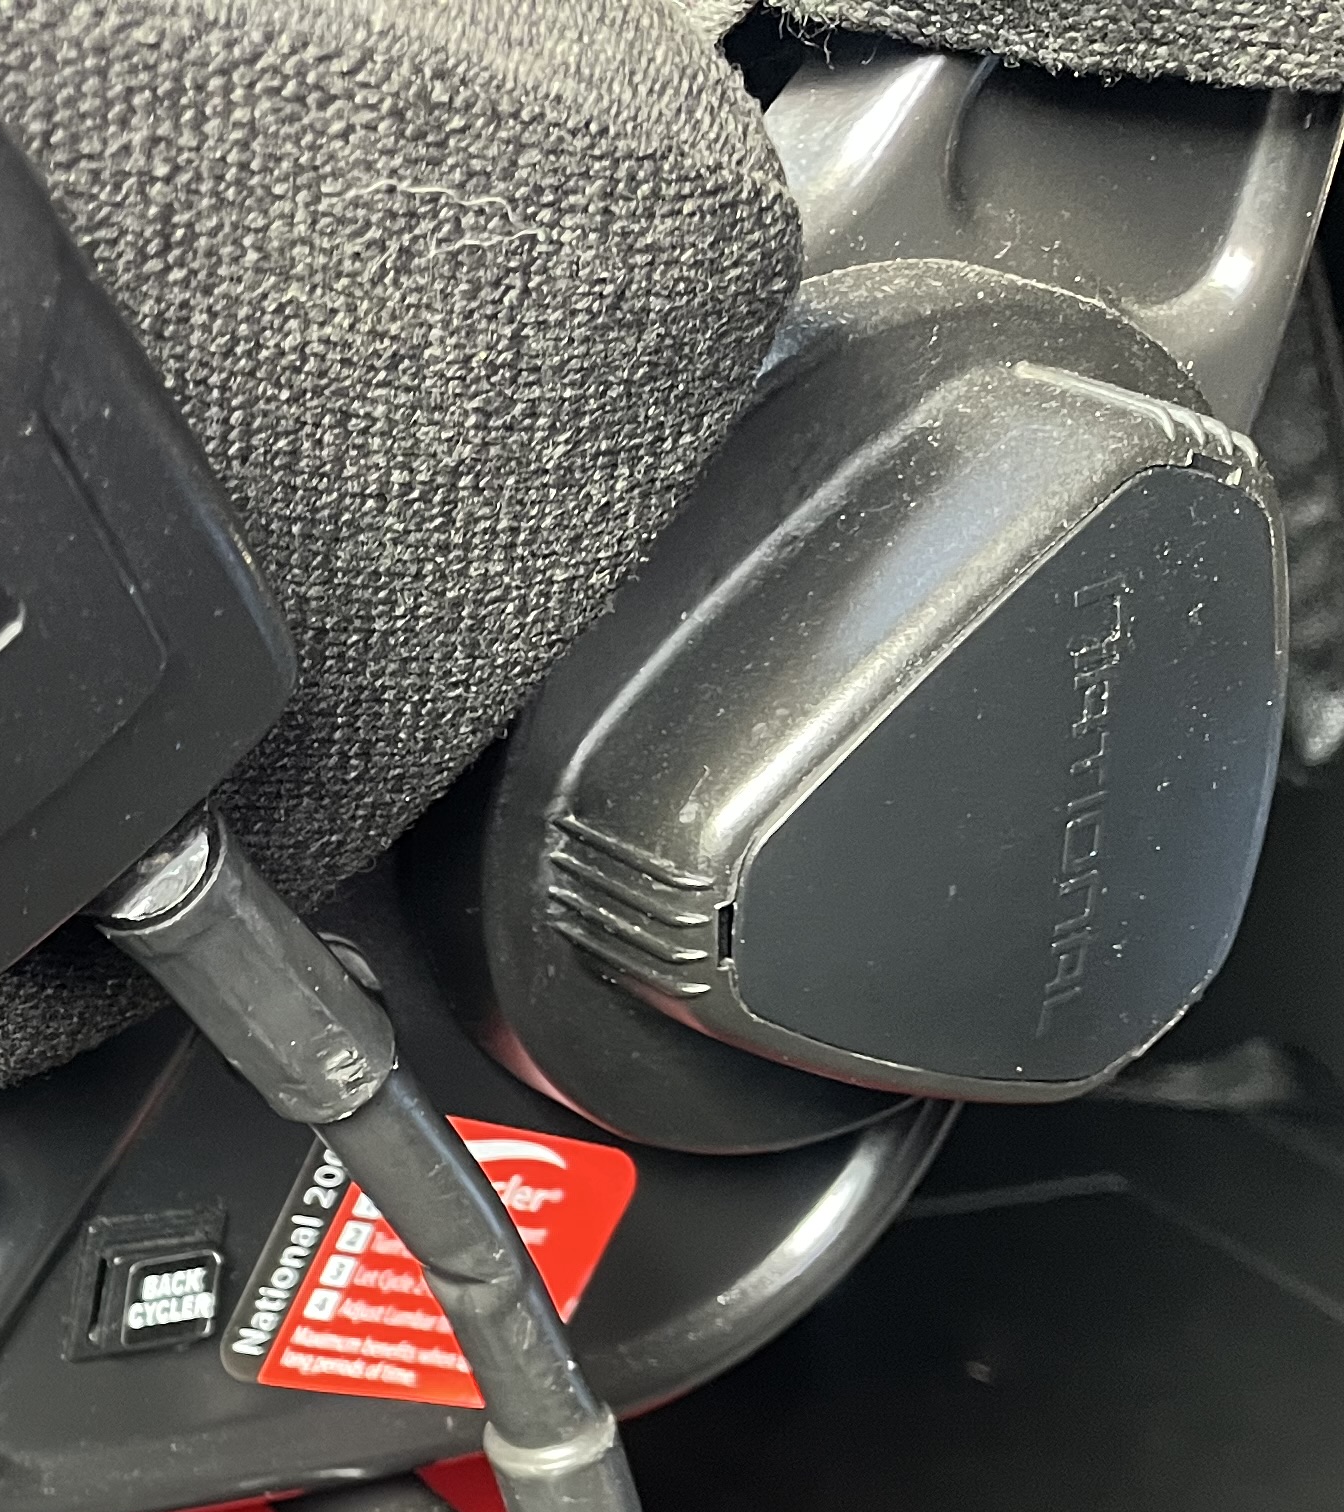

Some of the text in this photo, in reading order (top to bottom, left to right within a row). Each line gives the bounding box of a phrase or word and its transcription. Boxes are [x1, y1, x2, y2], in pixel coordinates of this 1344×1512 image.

[142, 1267, 207, 1300] BACK
[232, 1215, 324, 1355] National
[128, 1292, 214, 1329] CYCLER
